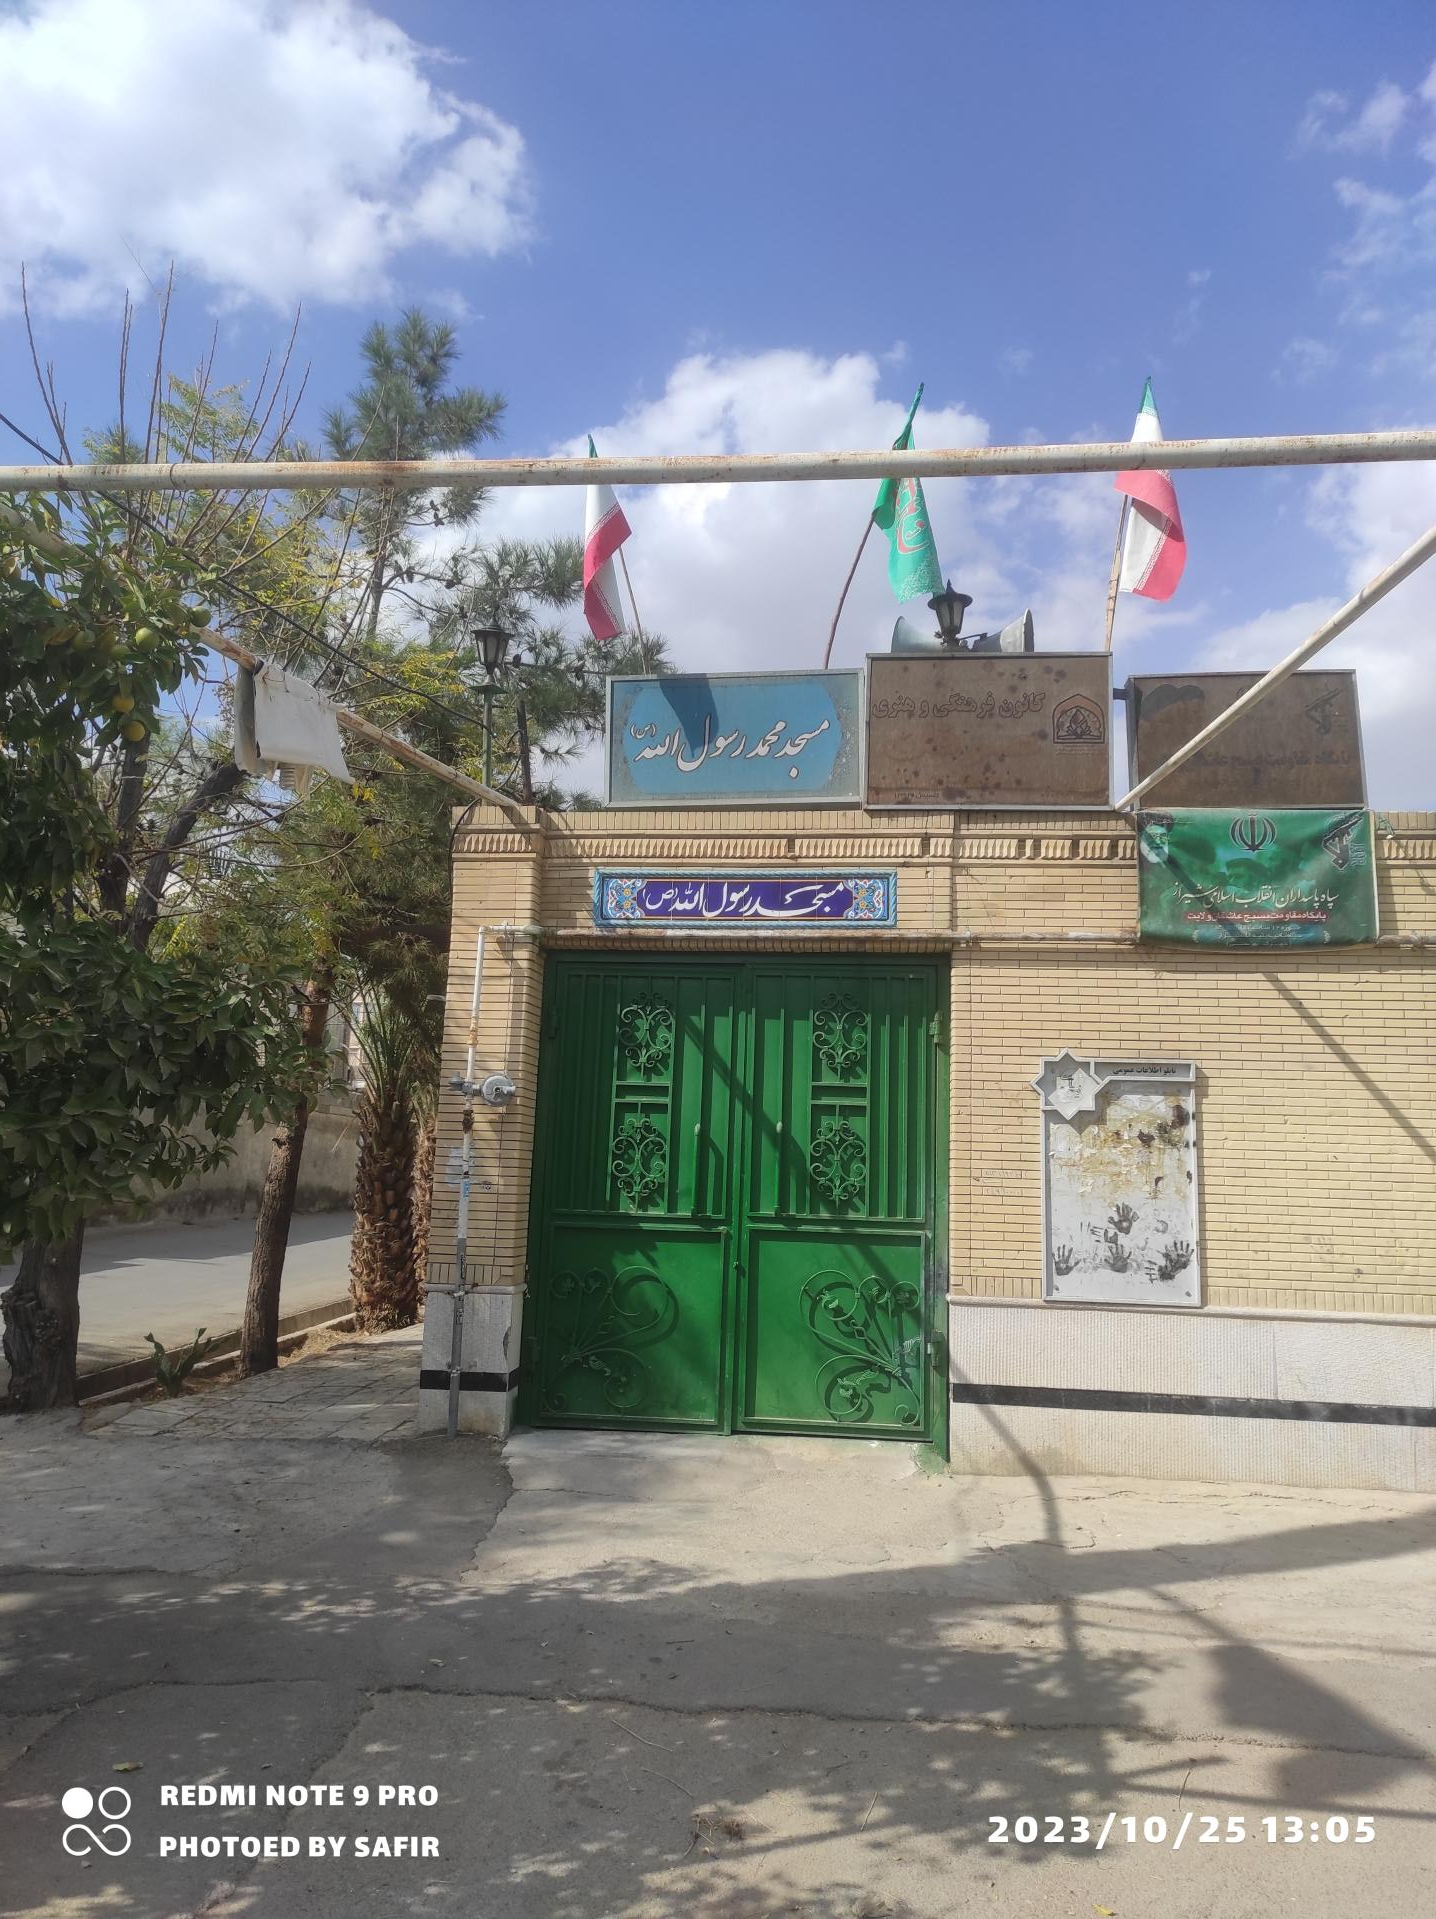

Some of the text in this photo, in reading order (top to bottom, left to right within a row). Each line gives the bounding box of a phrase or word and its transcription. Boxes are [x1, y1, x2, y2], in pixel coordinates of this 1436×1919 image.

[872, 691, 1046, 719] کانون فرهنگی و هنری
[634, 728, 680, 762] الله
[676, 713, 746, 772] رسول
[745, 720, 787, 760] محمد
[773, 719, 831, 779] مسجد
[671, 881, 705, 912] الله
[702, 881, 752, 918] رسول
[743, 880, 846, 917] مسجد
[1172, 881, 1340, 909] سپاه پاسداران انقلاب اسلامی شیراز
[1187, 911, 1212, 922] ولایت
[1243, 912, 1270, 923] بسیج
[1270, 911, 1303, 921] مقاومت
[1303, 911, 1327, 922] پایگاه
[1112, 1067, 1134, 1075] عمومی
[1135, 1065, 1162, 1074] اطلاعات
